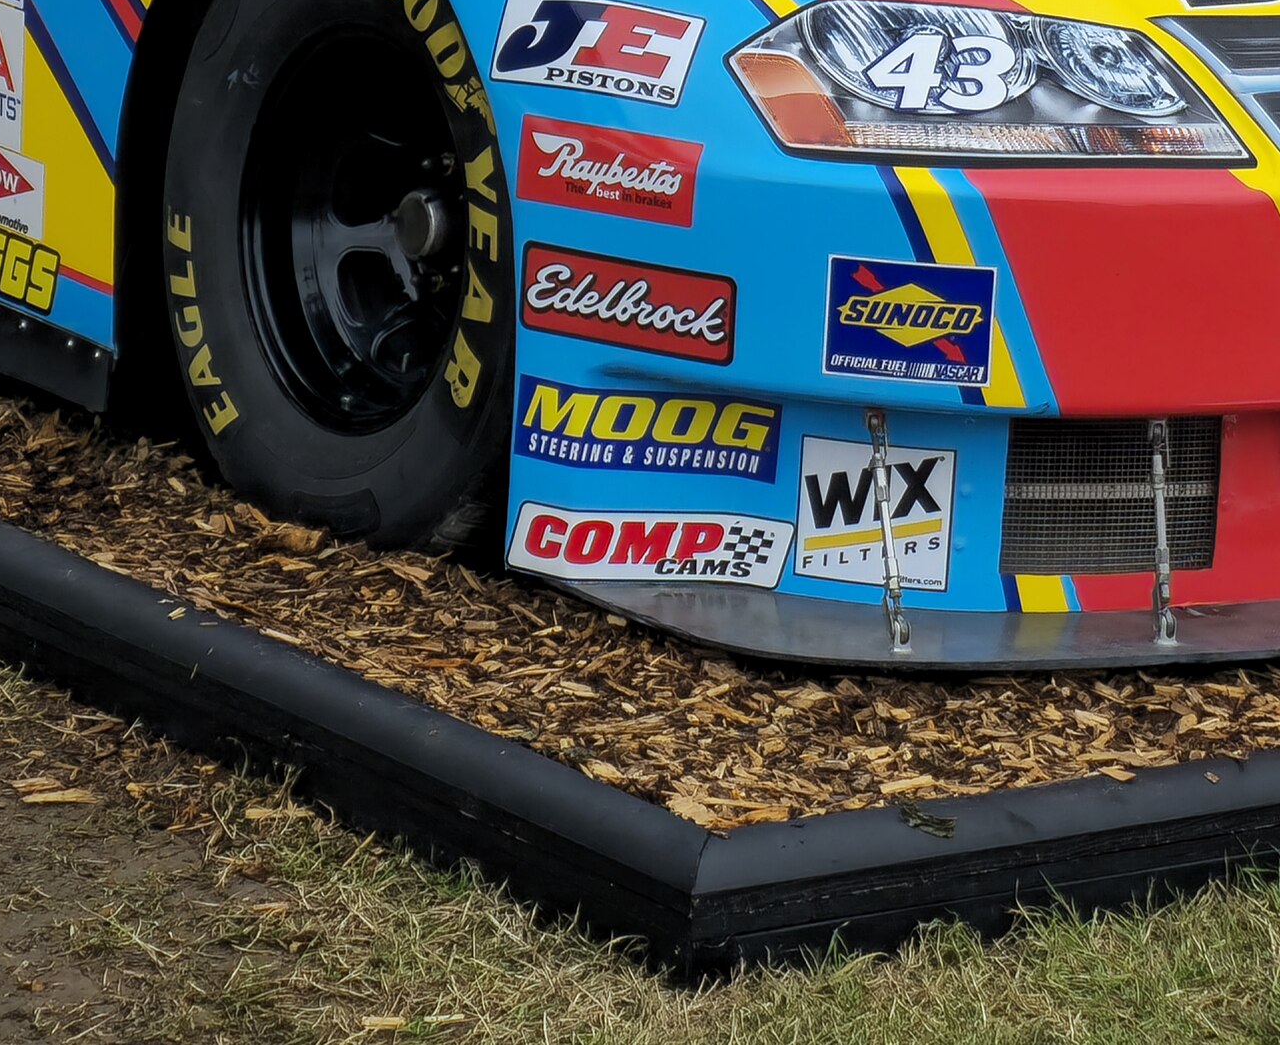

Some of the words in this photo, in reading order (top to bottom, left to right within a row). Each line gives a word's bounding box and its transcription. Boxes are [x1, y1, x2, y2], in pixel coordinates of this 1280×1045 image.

[496, 0, 691, 79] JE
[544, 67, 676, 101] PISTONS
[868, 33, 1019, 113] 43
[531, 131, 682, 195] Raybestos
[565, 181, 586, 195] The
[596, 185, 620, 200] best
[167, 206, 240, 435] EAGLE
[526, 263, 726, 343] Edelbrock
[844, 299, 978, 331] SUNOCO
[830, 354, 878, 370] OFFICIAL
[880, 359, 907, 372] FUEL
[933, 365, 985, 381] NASCAR
[522, 384, 775, 451] MOOG
[528, 433, 614, 464] STEERING
[623, 446, 634, 464] &
[643, 446, 760, 474] SUSPENSION
[524, 514, 725, 565] COMP
[803, 537, 941, 569] FILTRS
[654, 558, 753, 578] CAMS
